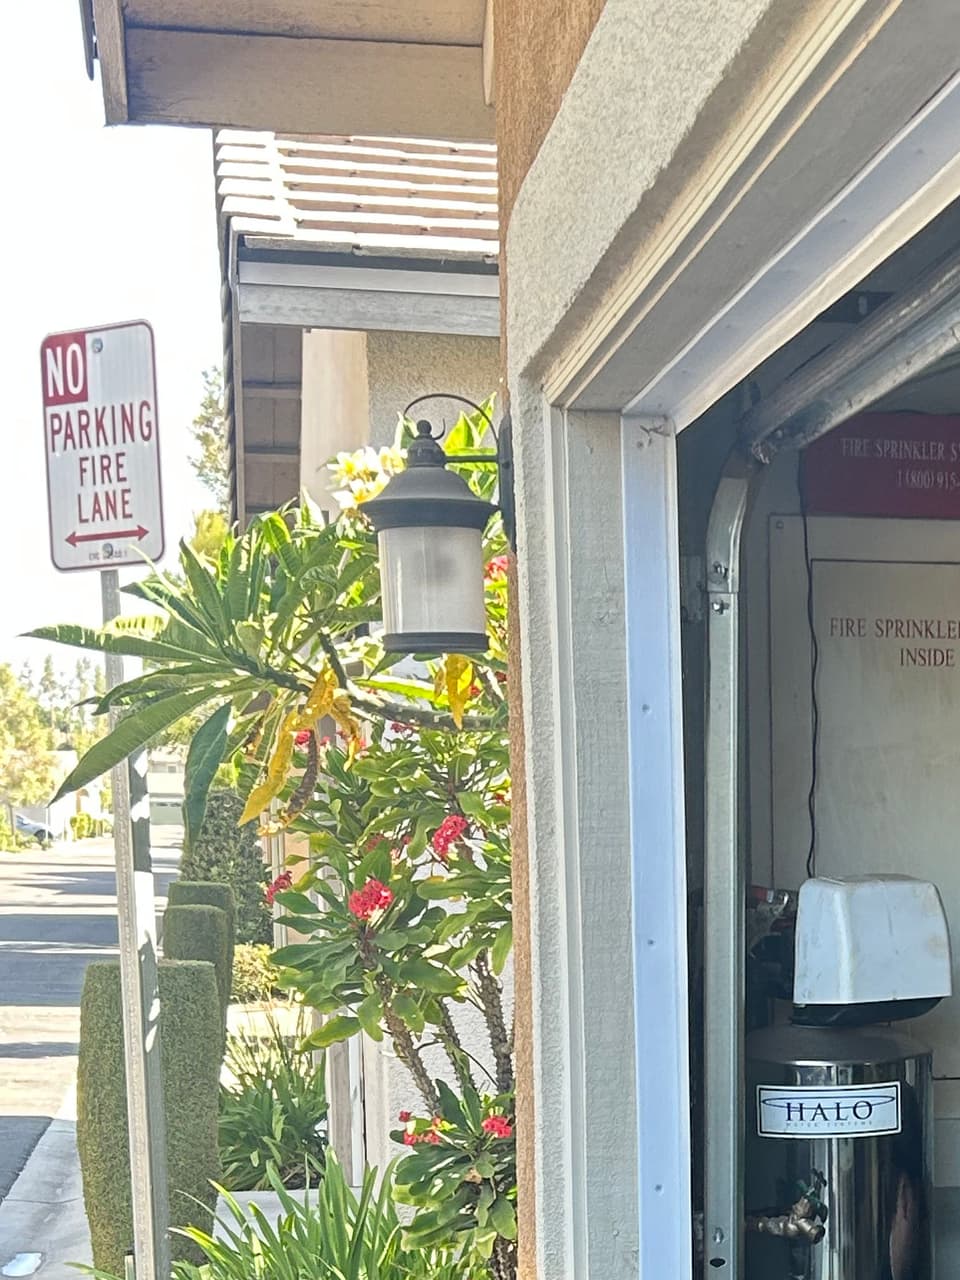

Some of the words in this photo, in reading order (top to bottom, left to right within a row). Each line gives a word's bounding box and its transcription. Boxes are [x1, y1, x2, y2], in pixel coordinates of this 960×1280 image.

[46, 342, 85, 398] NO
[50, 400, 152, 452] PARKING
[840, 438, 870, 458] FIRE
[873, 439, 947, 462] SPRINKLER
[79, 452, 127, 487] FIRE
[905, 470, 935, 490] (800)
[77, 488, 133, 524] LANE
[829, 617, 867, 638] FIRE
[899, 648, 956, 668] INSIDE
[785, 1100, 873, 1122] HALO
